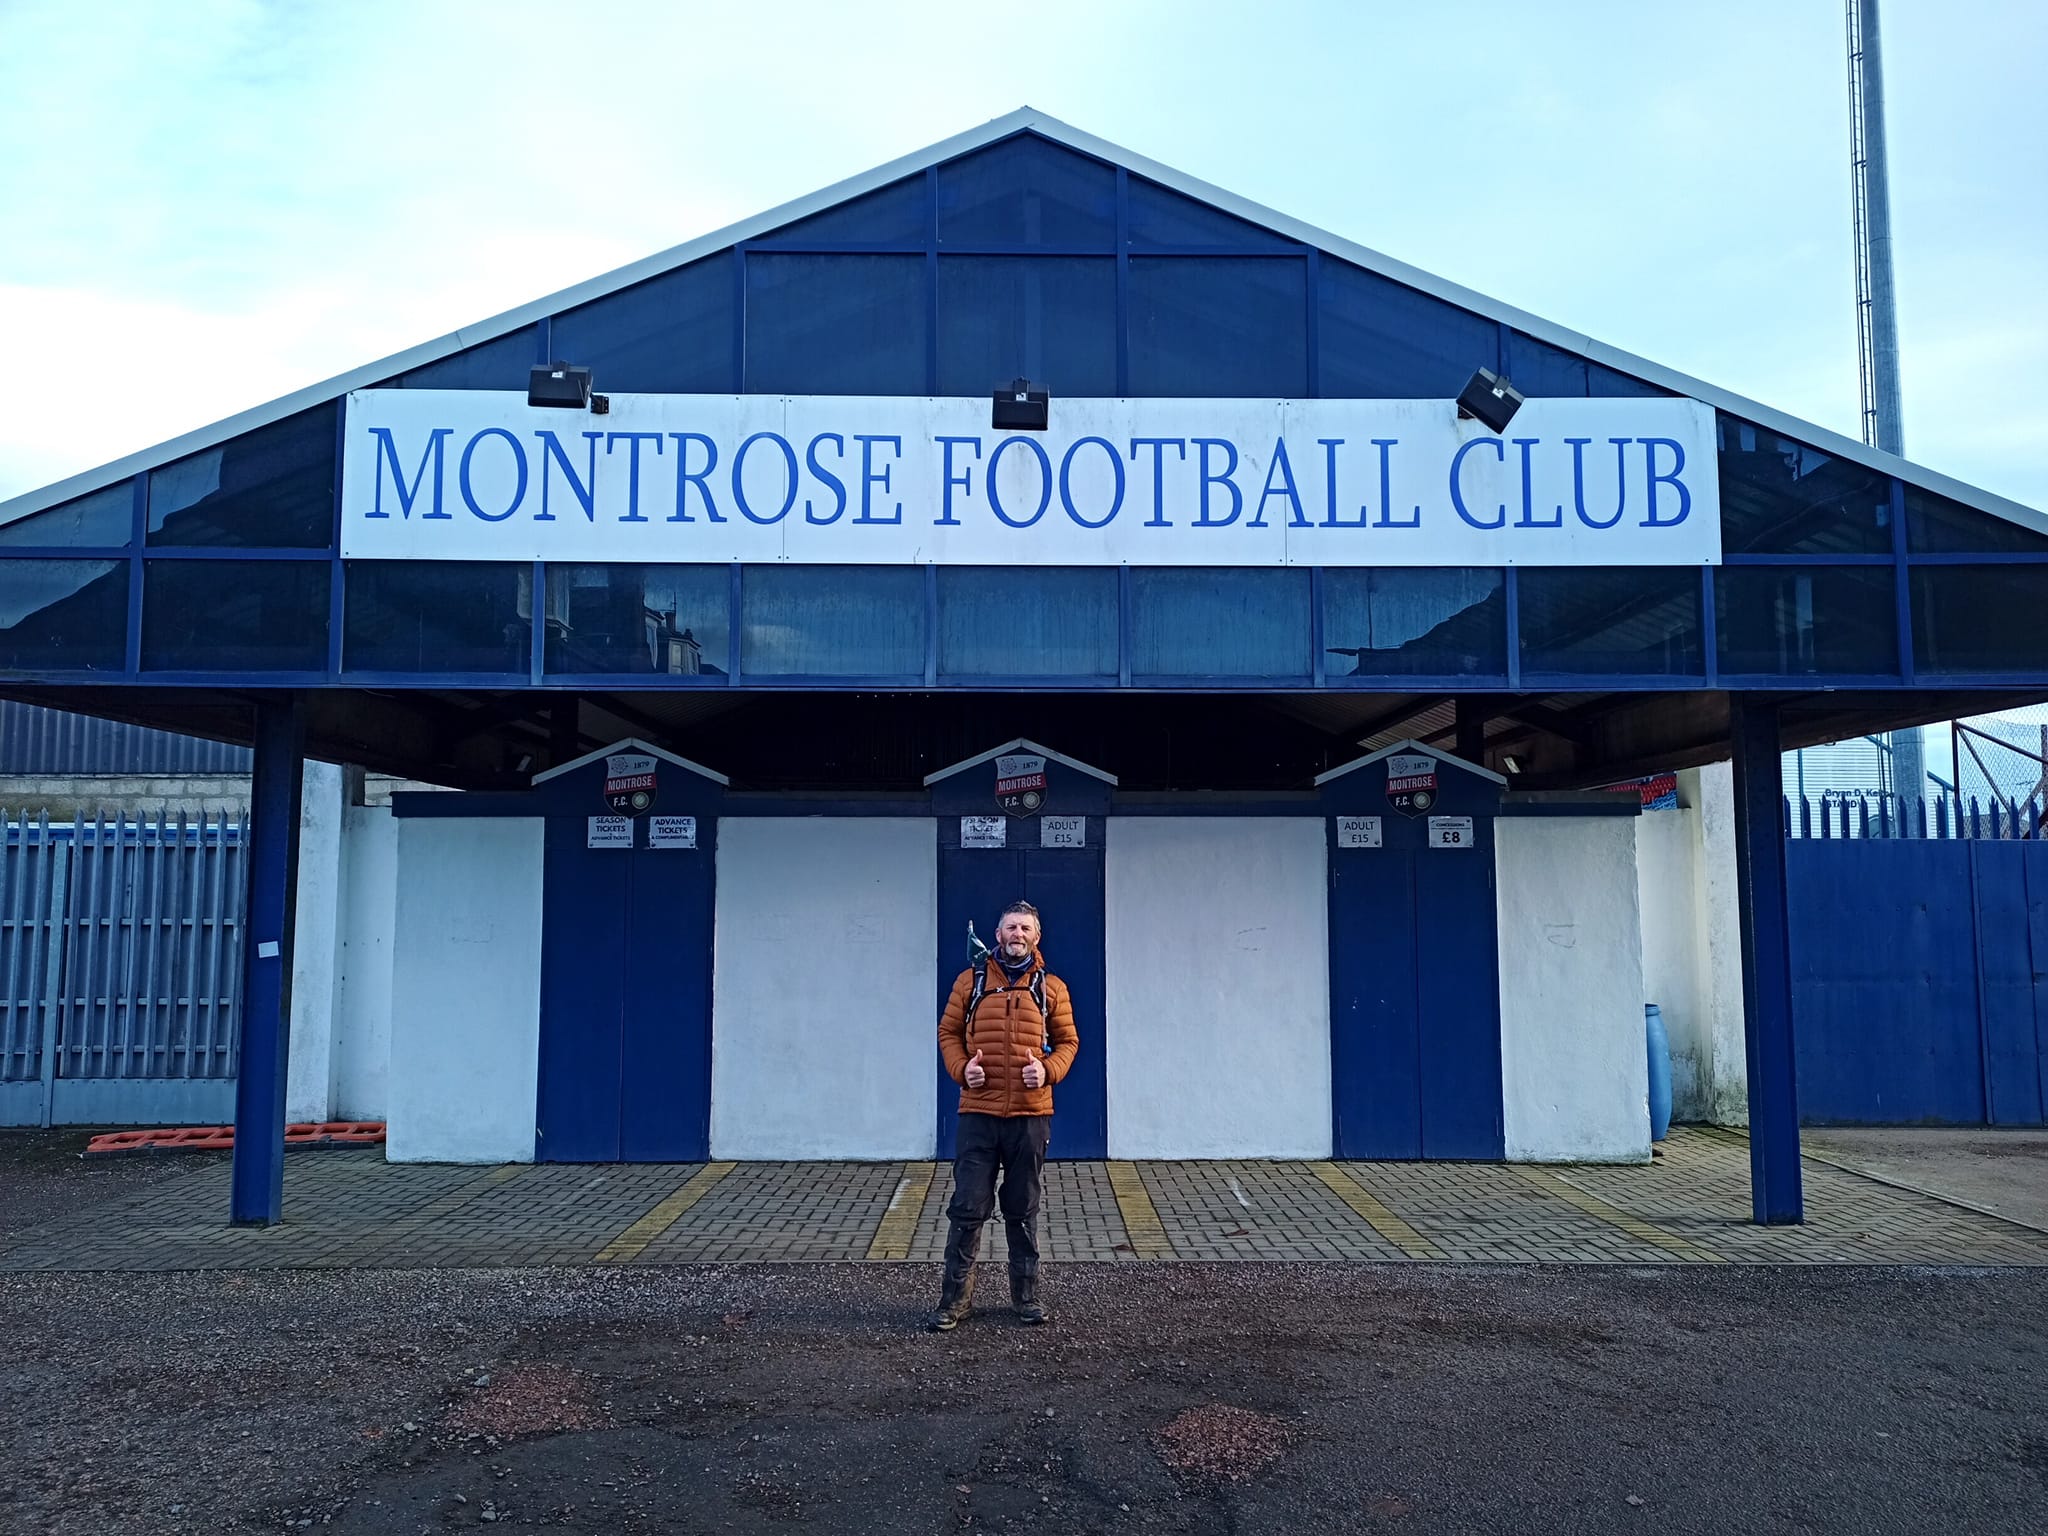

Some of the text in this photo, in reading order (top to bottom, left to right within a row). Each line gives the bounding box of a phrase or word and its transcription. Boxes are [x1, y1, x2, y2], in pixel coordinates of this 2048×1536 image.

[364, 427, 1691, 530] MONTROSE FOOTBALL CLUB
[633, 761, 650, 769] 1879
[1022, 761, 1038, 769] 1879
[1413, 761, 1429, 769] 1879
[607, 775, 653, 791] MONTROSE
[998, 775, 1042, 792] MONTROSE
[1389, 775, 1433, 791] MONTROSE
[613, 796, 628, 807] F.C.
[1005, 796, 1020, 807] F.C.
[1395, 796, 1410, 807] F.C.
[1825, 800, 1857, 808] STAD
[1048, 822, 1078, 830] ADULT
[1344, 821, 1375, 831] ADULT
[1054, 833, 1072, 843] £15
[1442, 831, 1460, 843] £8
